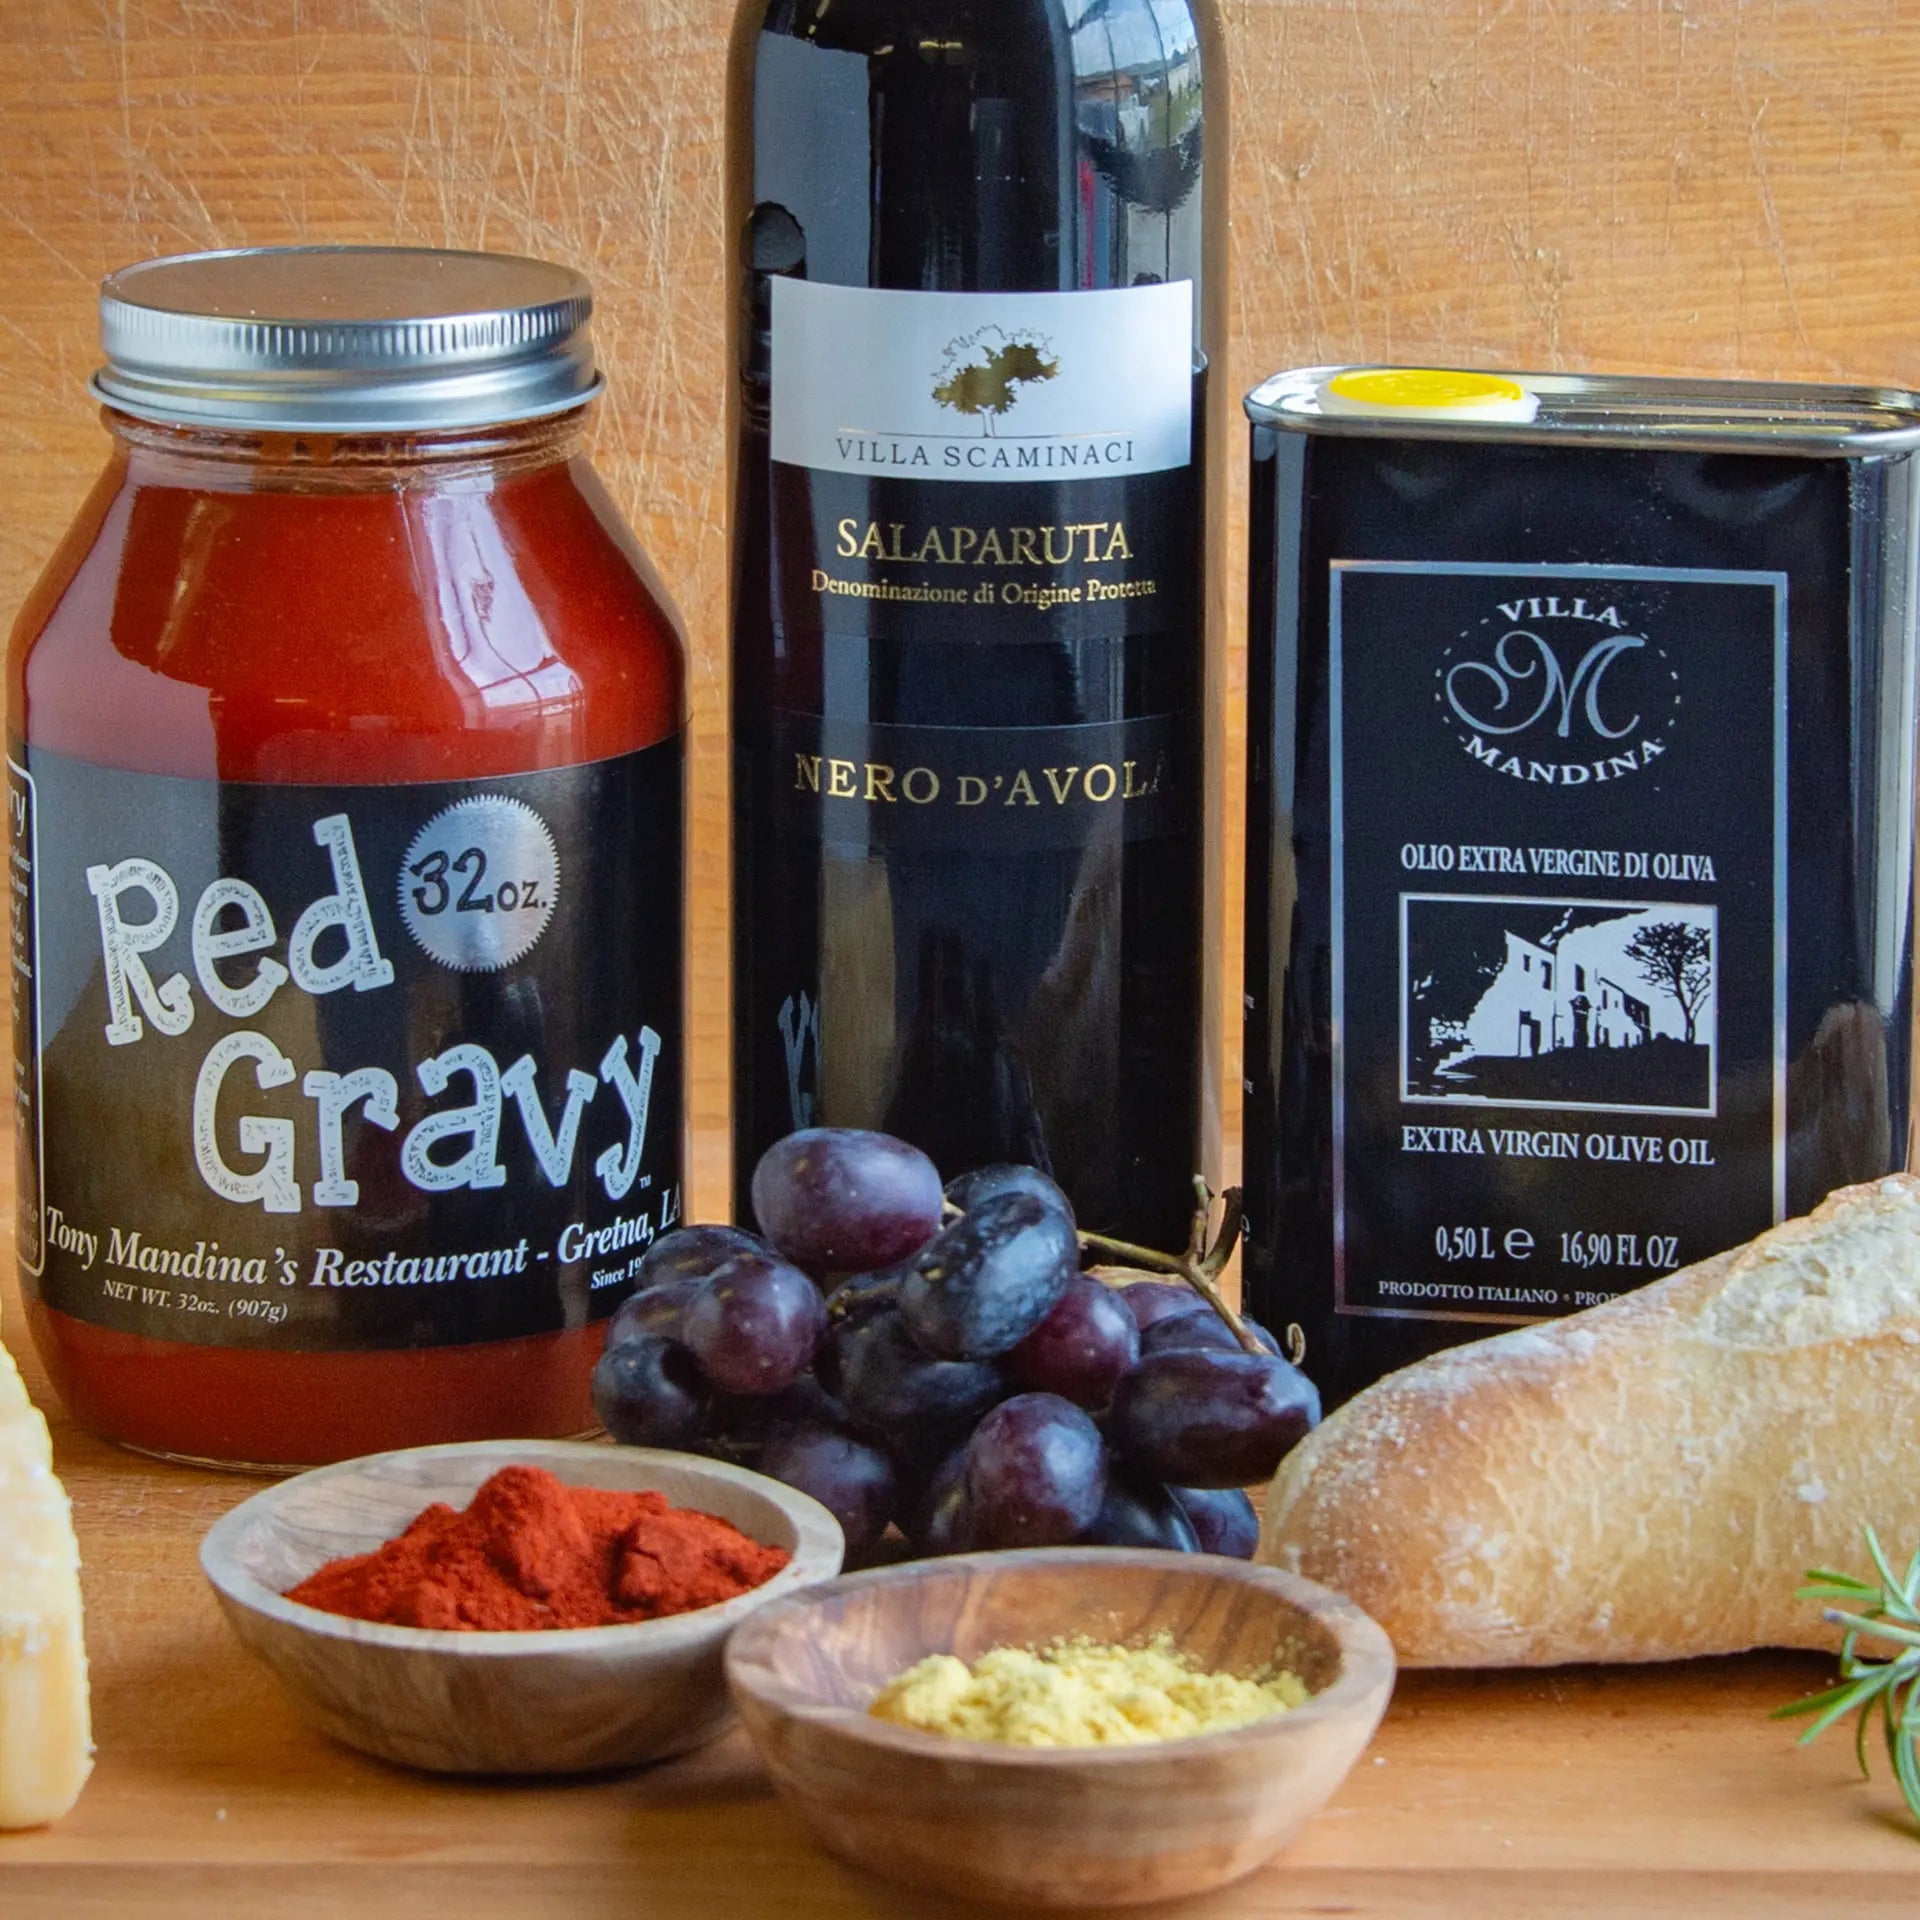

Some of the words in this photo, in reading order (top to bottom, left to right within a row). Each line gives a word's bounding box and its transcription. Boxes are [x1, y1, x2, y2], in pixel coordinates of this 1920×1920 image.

[836, 437, 931, 467] VILLA
[943, 440, 1135, 470] SCAMINACI
[836, 518, 1134, 565] SALAPARUTA
[812, 569, 968, 604] Denominazione
[973, 582, 996, 604] di
[1001, 582, 1082, 610] Origine
[1496, 596, 1622, 629] VILLA
[794, 753, 941, 804] NERO
[1464, 734, 1667, 785] MANDINA
[1401, 844, 1454, 871] OLIO
[1458, 846, 1526, 874] EXTRA
[1529, 848, 1621, 878] VERGINE
[1624, 852, 1650, 878] DI
[1653, 853, 1717, 882] OLIVA
[86, 813, 395, 1045] Red
[193, 1024, 662, 1213] Gravy
[1401, 1126, 1484, 1154] EXTRA
[1490, 1129, 1580, 1159] VIRGIN
[1585, 1133, 1663, 1162] OLIVE
[1668, 1137, 1715, 1166] OIL
[47, 1206, 99, 1271] Tony
[105, 1227, 299, 1287] Mandina's
[308, 1238, 529, 1287] Restaurant
[558, 1212, 655, 1264] Gretna,
[1435, 1225, 1477, 1262] 0,50
[1560, 1230, 1612, 1269] 16,90
[1616, 1233, 1643, 1267] FL
[1646, 1235, 1680, 1269] OZ
[590, 1268, 625, 1289] Since
[1378, 1279, 1474, 1300] PRODOTTO
[1477, 1285, 1558, 1305] ITALIANO
[102, 1279, 138, 1301] NET
[142, 1287, 172, 1308] WT.
[175, 1292, 221, 1315] 32oz.
[228, 1298, 289, 1325] (907g)
